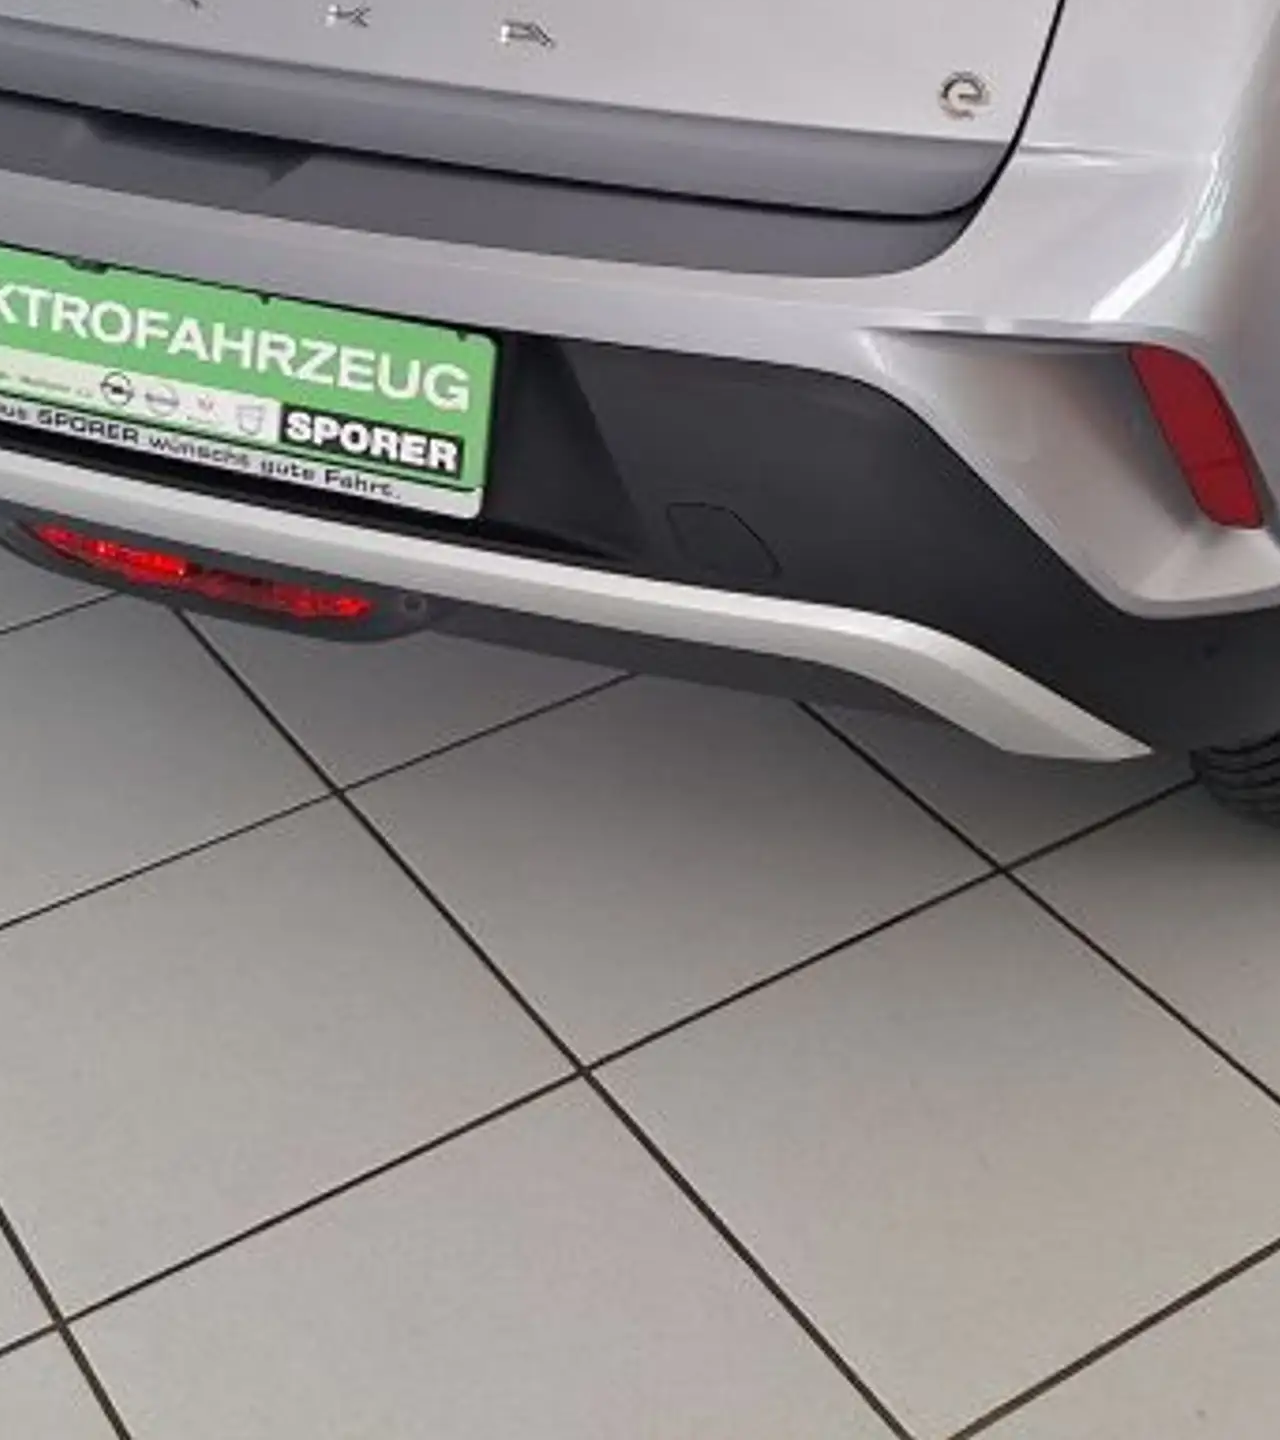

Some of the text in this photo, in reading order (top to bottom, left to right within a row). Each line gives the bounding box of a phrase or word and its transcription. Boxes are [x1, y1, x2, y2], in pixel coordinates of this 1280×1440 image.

[37, 408, 139, 445] SPORER
[260, 459, 315, 482] gute
[285, 410, 458, 472] SPORER
